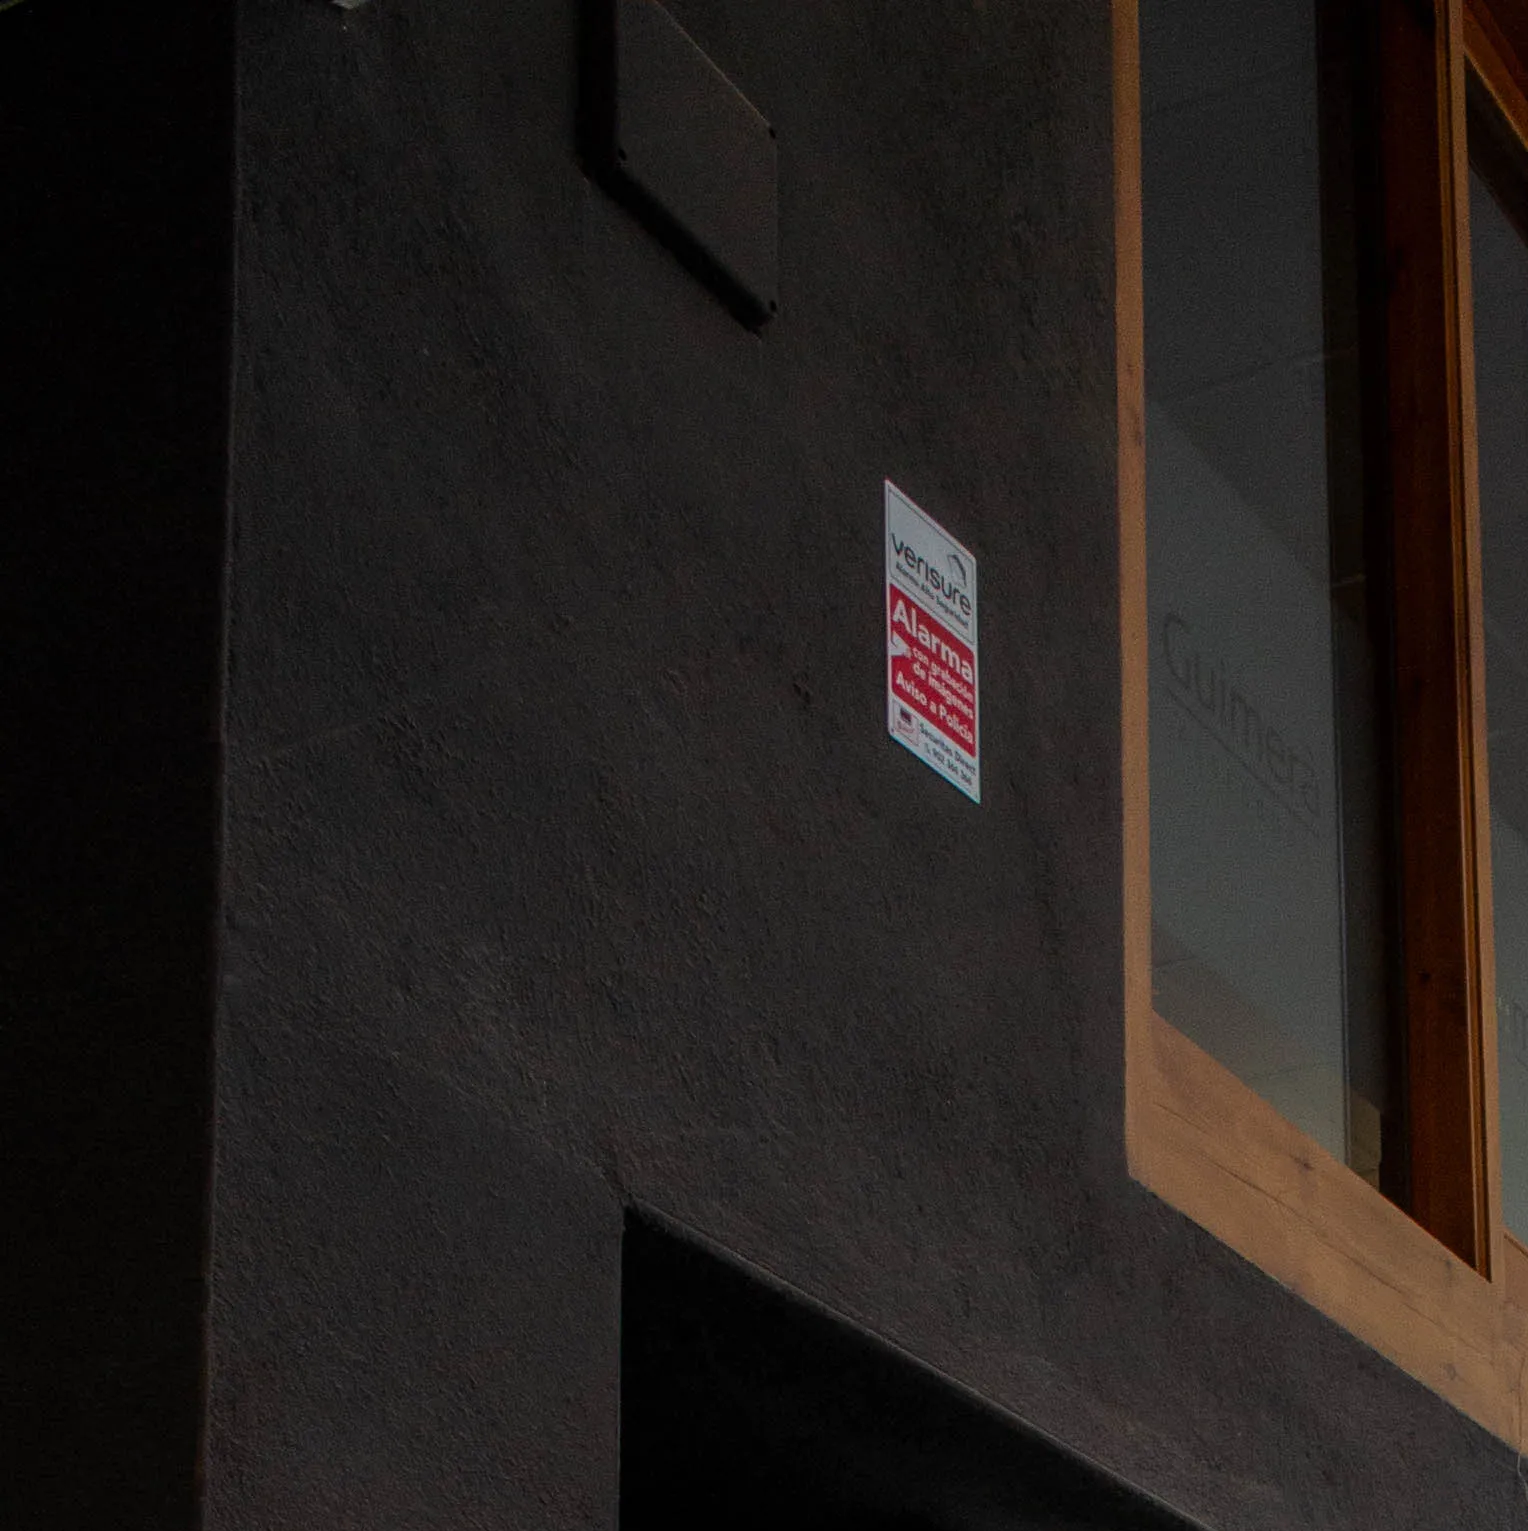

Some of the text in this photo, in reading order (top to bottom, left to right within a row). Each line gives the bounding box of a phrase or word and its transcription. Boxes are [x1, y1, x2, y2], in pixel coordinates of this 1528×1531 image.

[891, 532, 972, 617] verisure
[891, 599, 974, 685] Alarma
[912, 648, 928, 665] con
[912, 663, 927, 681] de
[896, 670, 928, 707] Aviso
[929, 701, 937, 714] a
[939, 704, 974, 744] Policía
[919, 722, 977, 776] Securitas Direct
